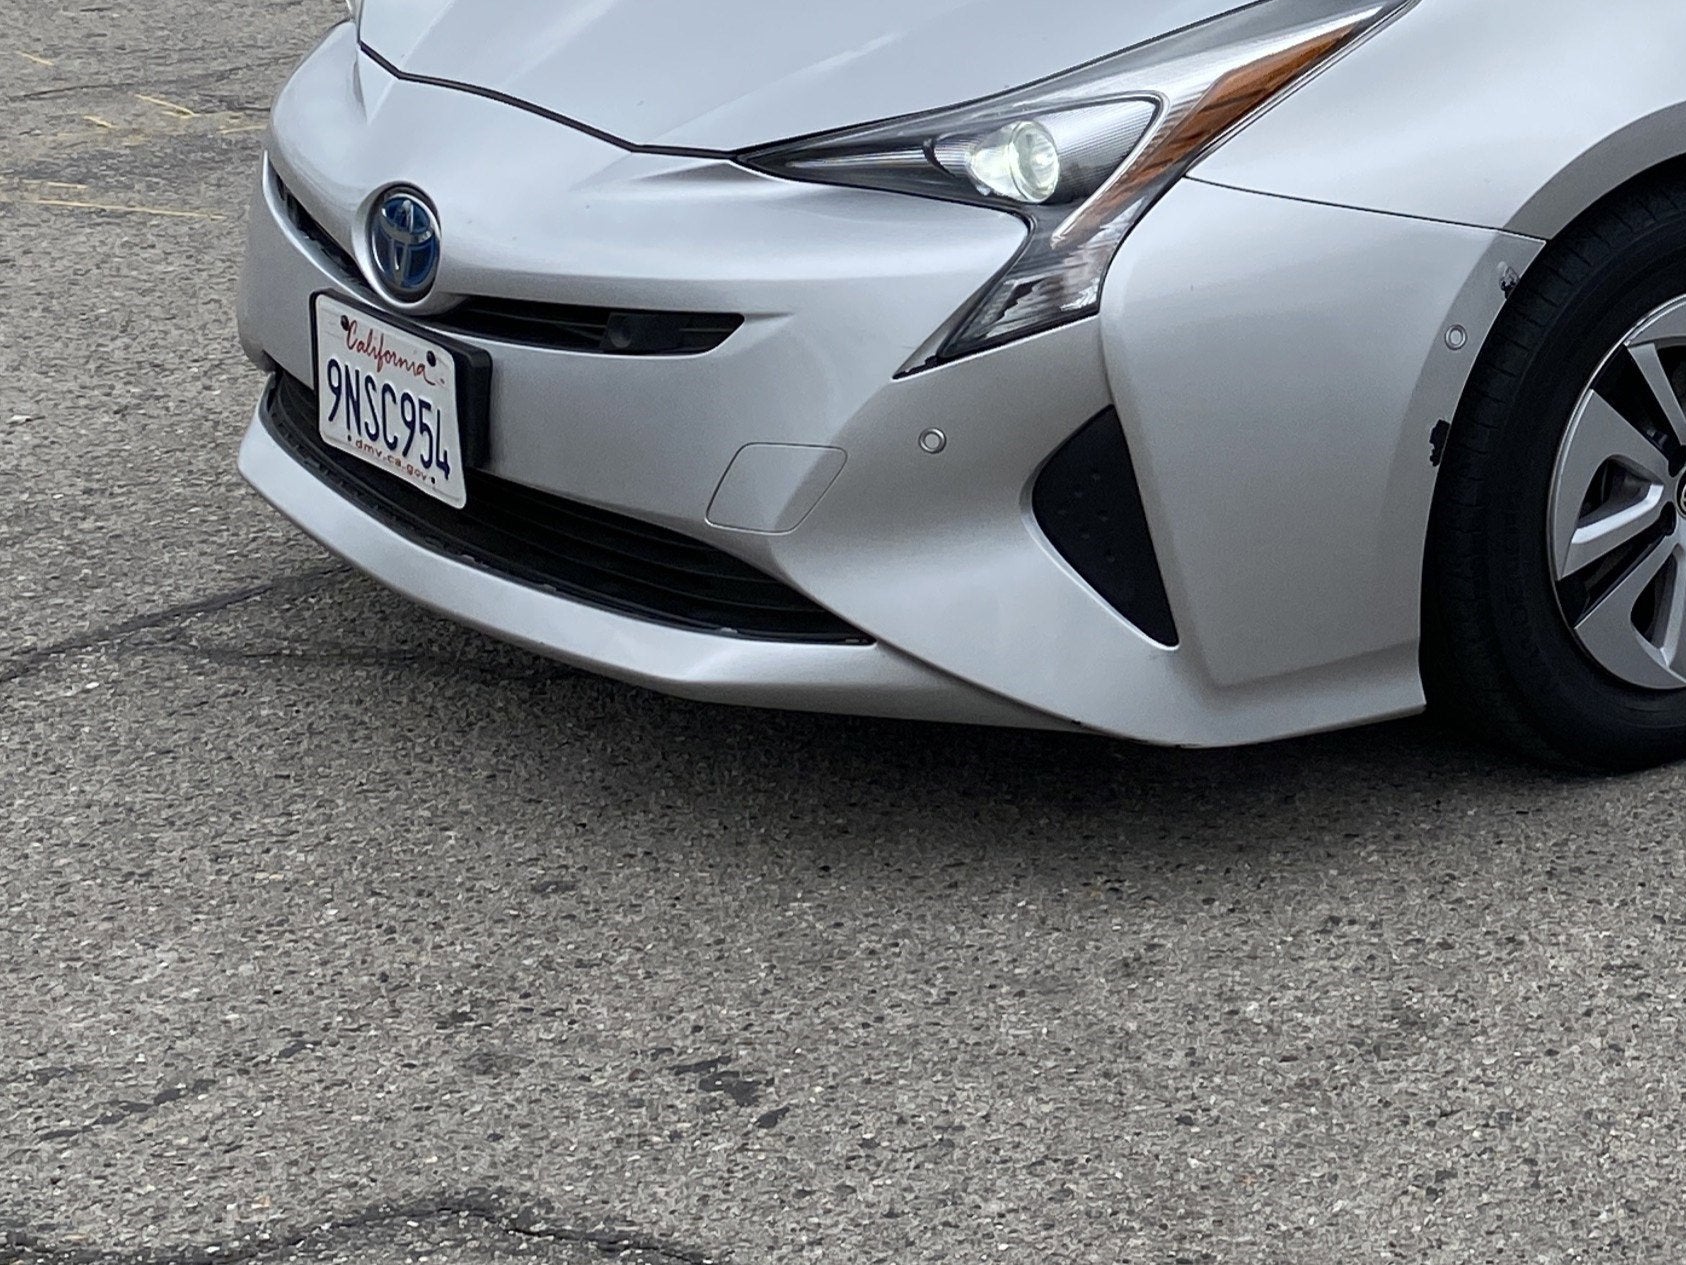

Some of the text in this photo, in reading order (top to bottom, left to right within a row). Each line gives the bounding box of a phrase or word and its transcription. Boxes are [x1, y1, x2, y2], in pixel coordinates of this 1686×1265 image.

[345, 319, 436, 386] California
[327, 358, 451, 481] 9NSC954
[354, 438, 428, 482] dmv.ca.gov
